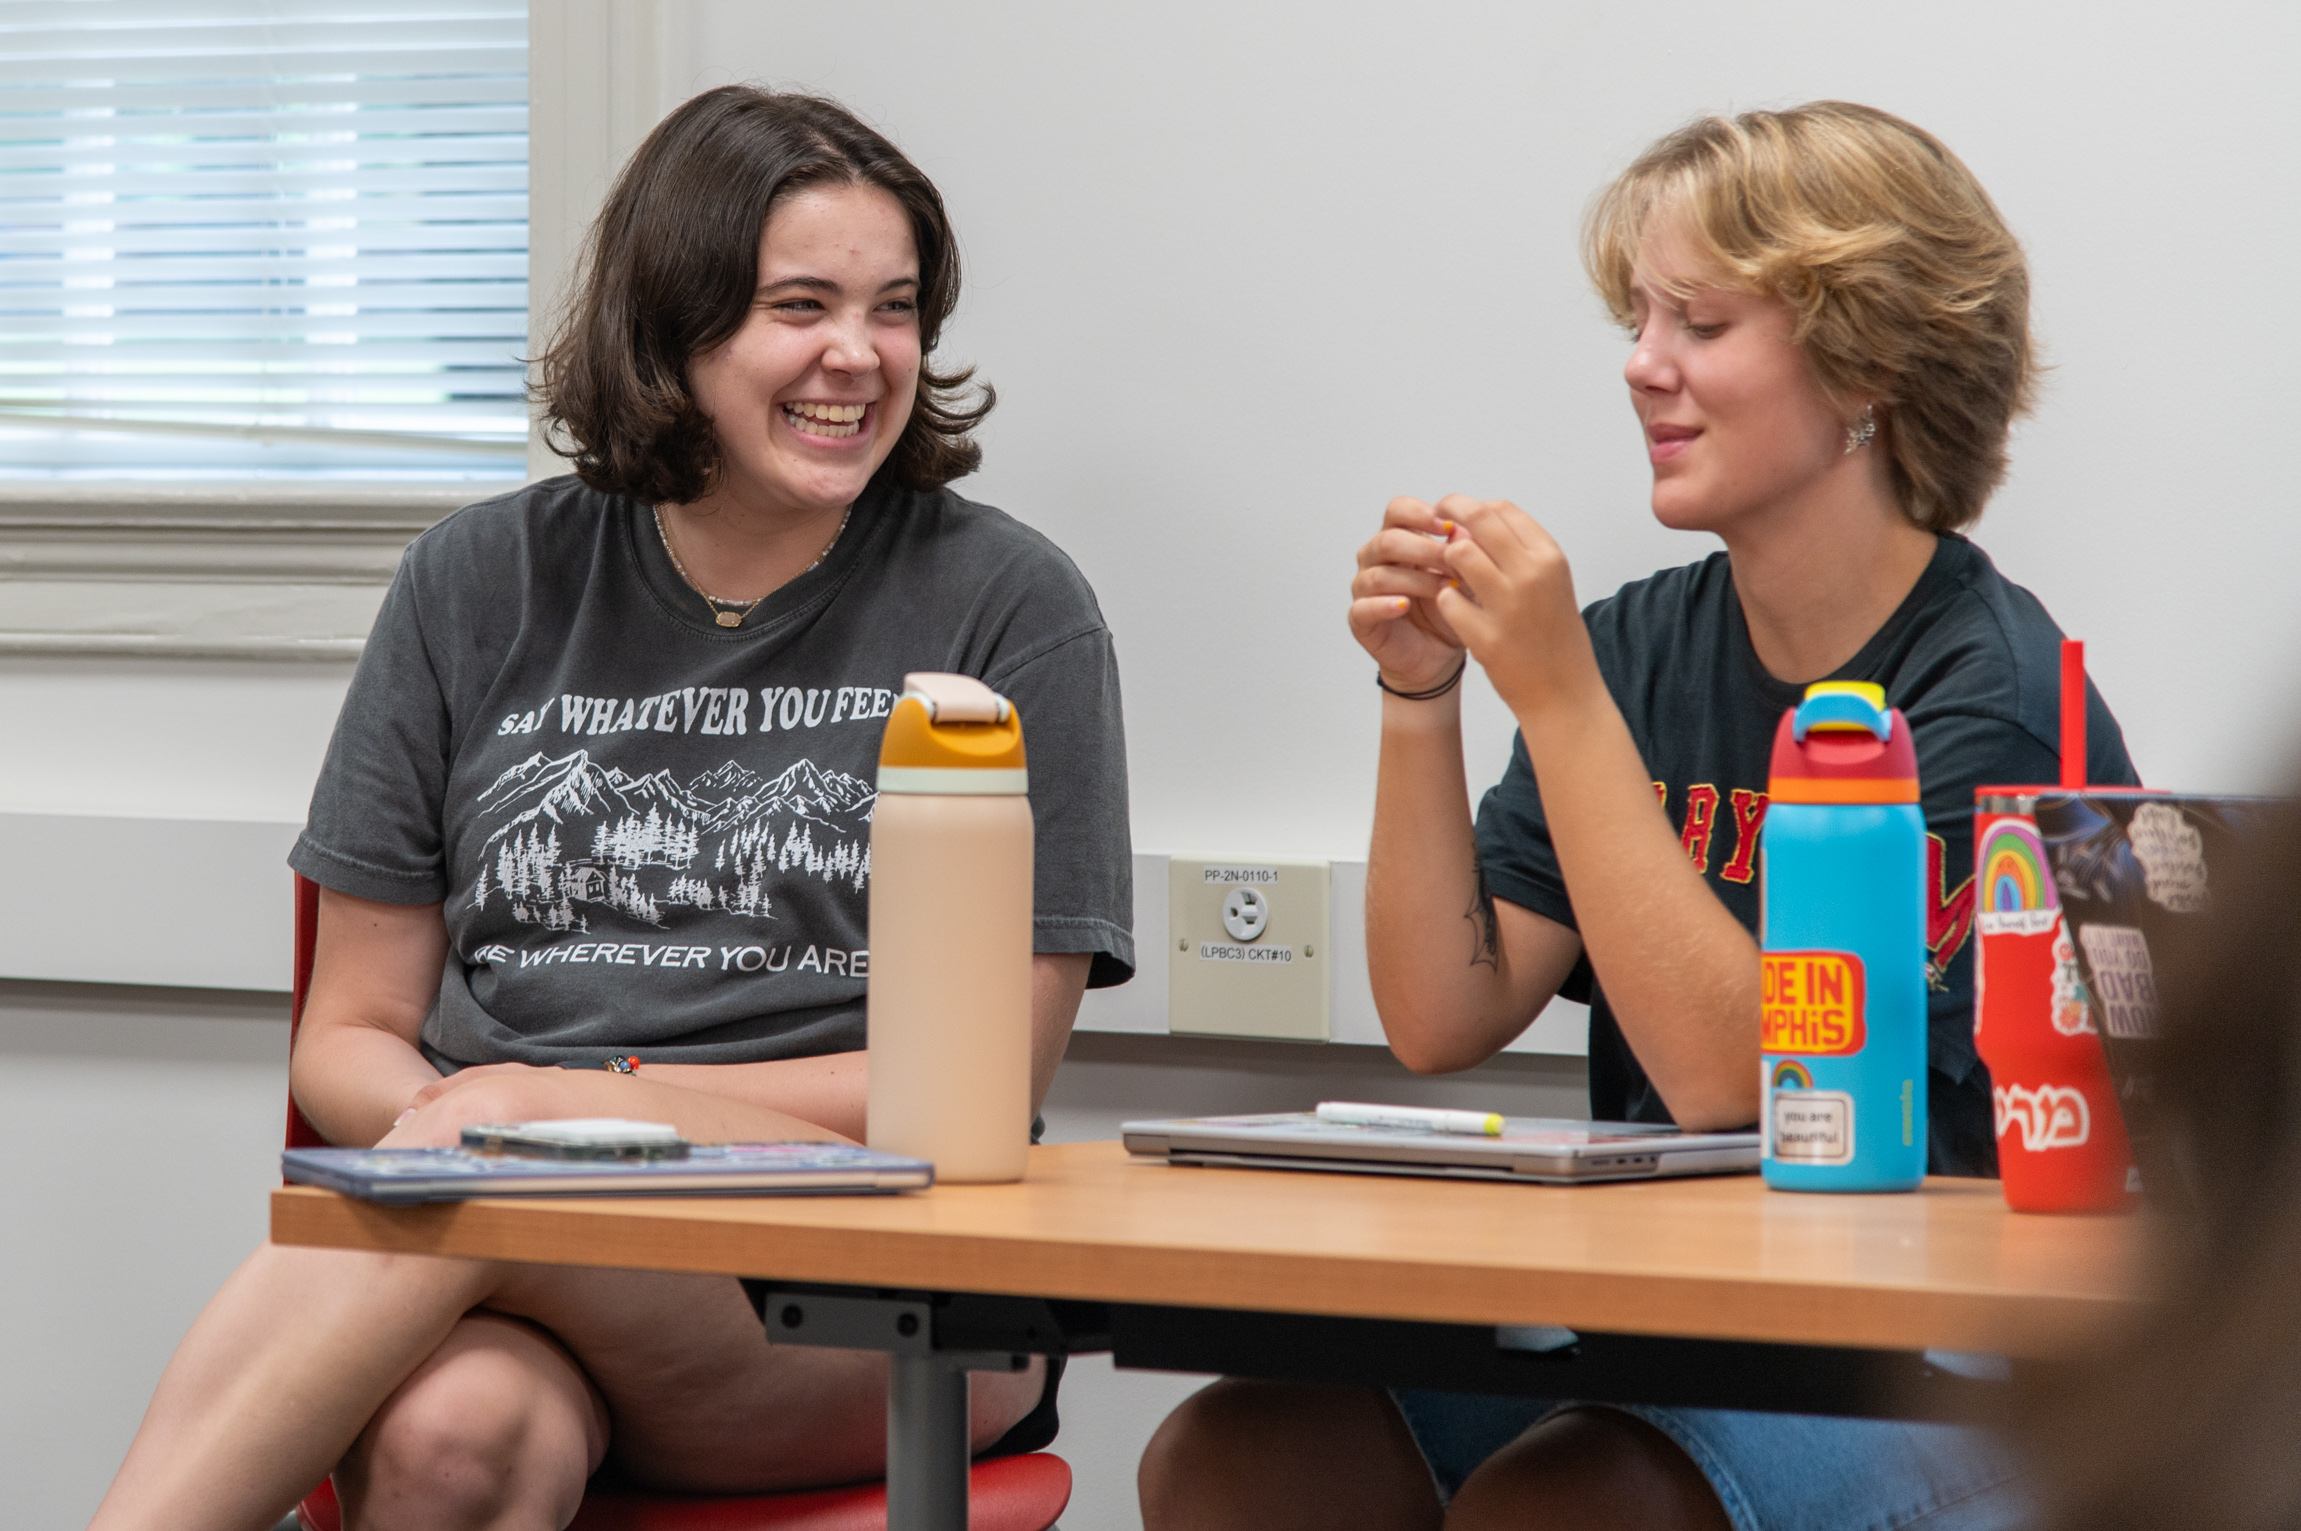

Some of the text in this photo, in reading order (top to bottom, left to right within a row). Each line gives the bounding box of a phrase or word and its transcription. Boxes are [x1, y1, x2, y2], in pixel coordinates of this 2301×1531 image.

[497, 697, 556, 736] SAY
[560, 687, 747, 736] WHATEVER
[755, 687, 832, 733] YOU
[1650, 780, 1769, 884] RY
[1204, 869, 1279, 882] PP-2N-0110-1
[520, 943, 711, 968] WHEREVER
[719, 946, 790, 972] YOU
[797, 945, 869, 978] ARE
[1201, 945, 1292, 962] (LPBC3) CKT#10
[1806, 962, 1844, 1005] IN
[1785, 1111, 1833, 1124] you are
